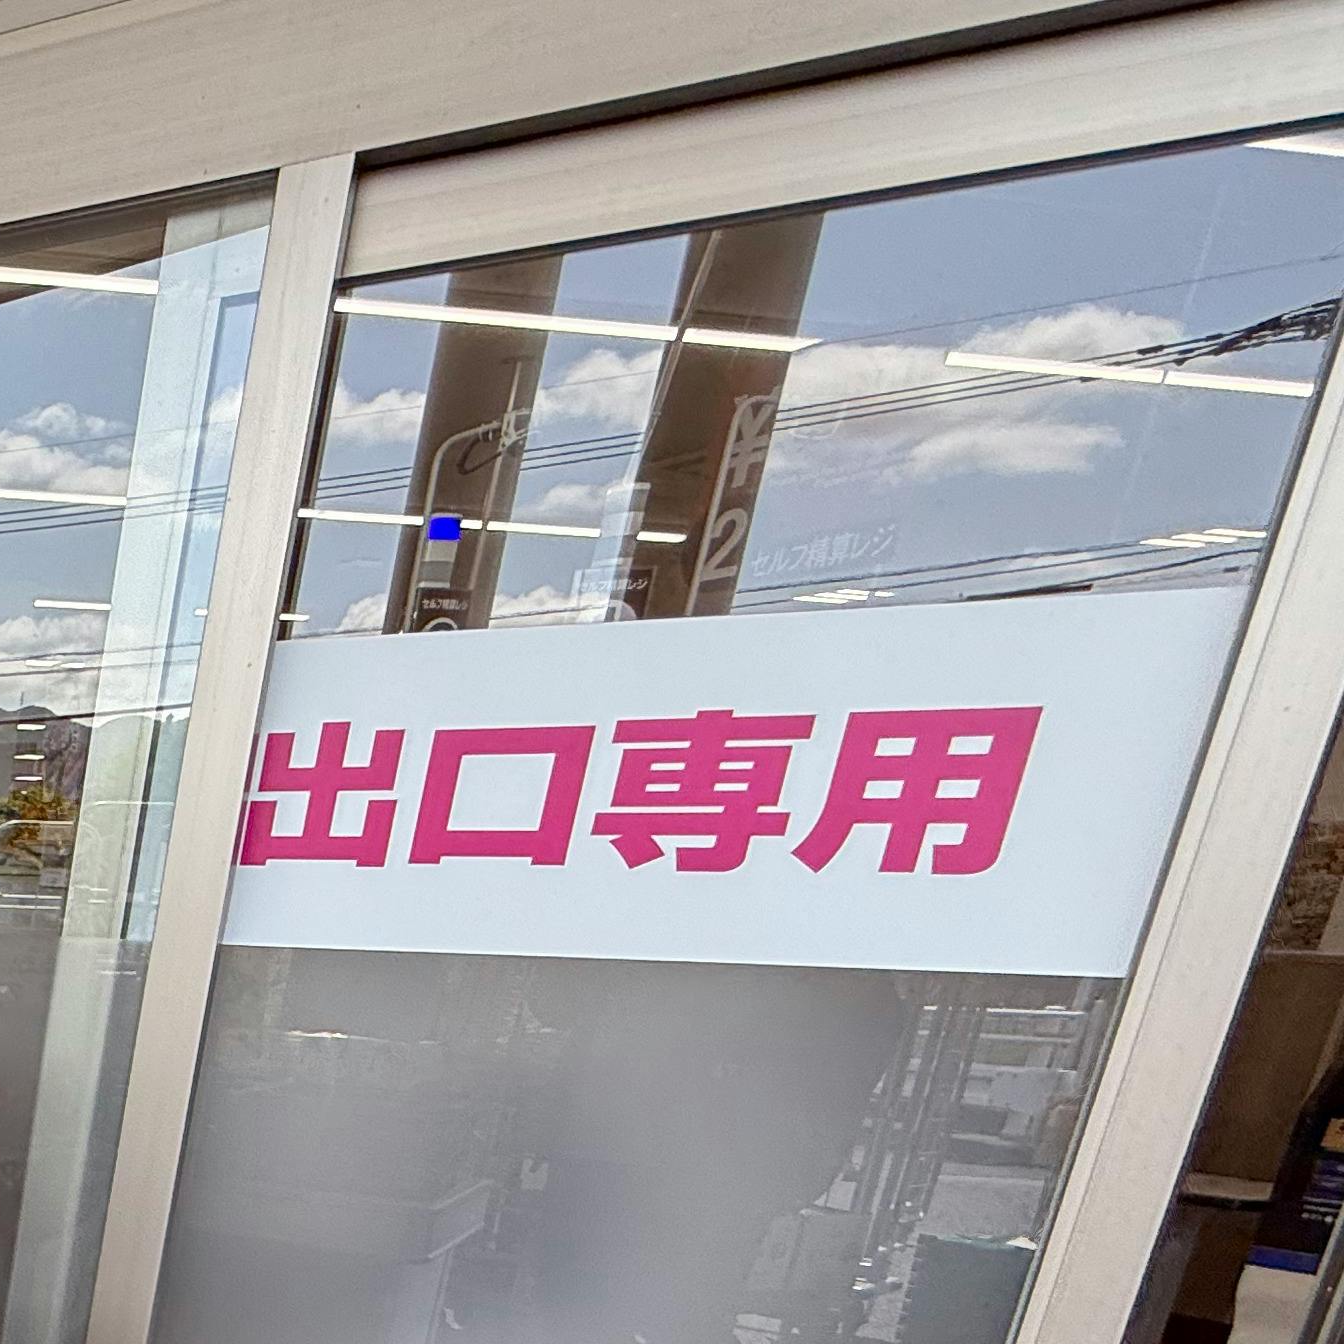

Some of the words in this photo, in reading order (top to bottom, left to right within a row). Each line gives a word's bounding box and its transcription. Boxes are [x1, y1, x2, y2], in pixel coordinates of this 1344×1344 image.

[751, 524, 896, 577] セルフ精算レジ
[240, 706, 1044, 874] 出口専用
